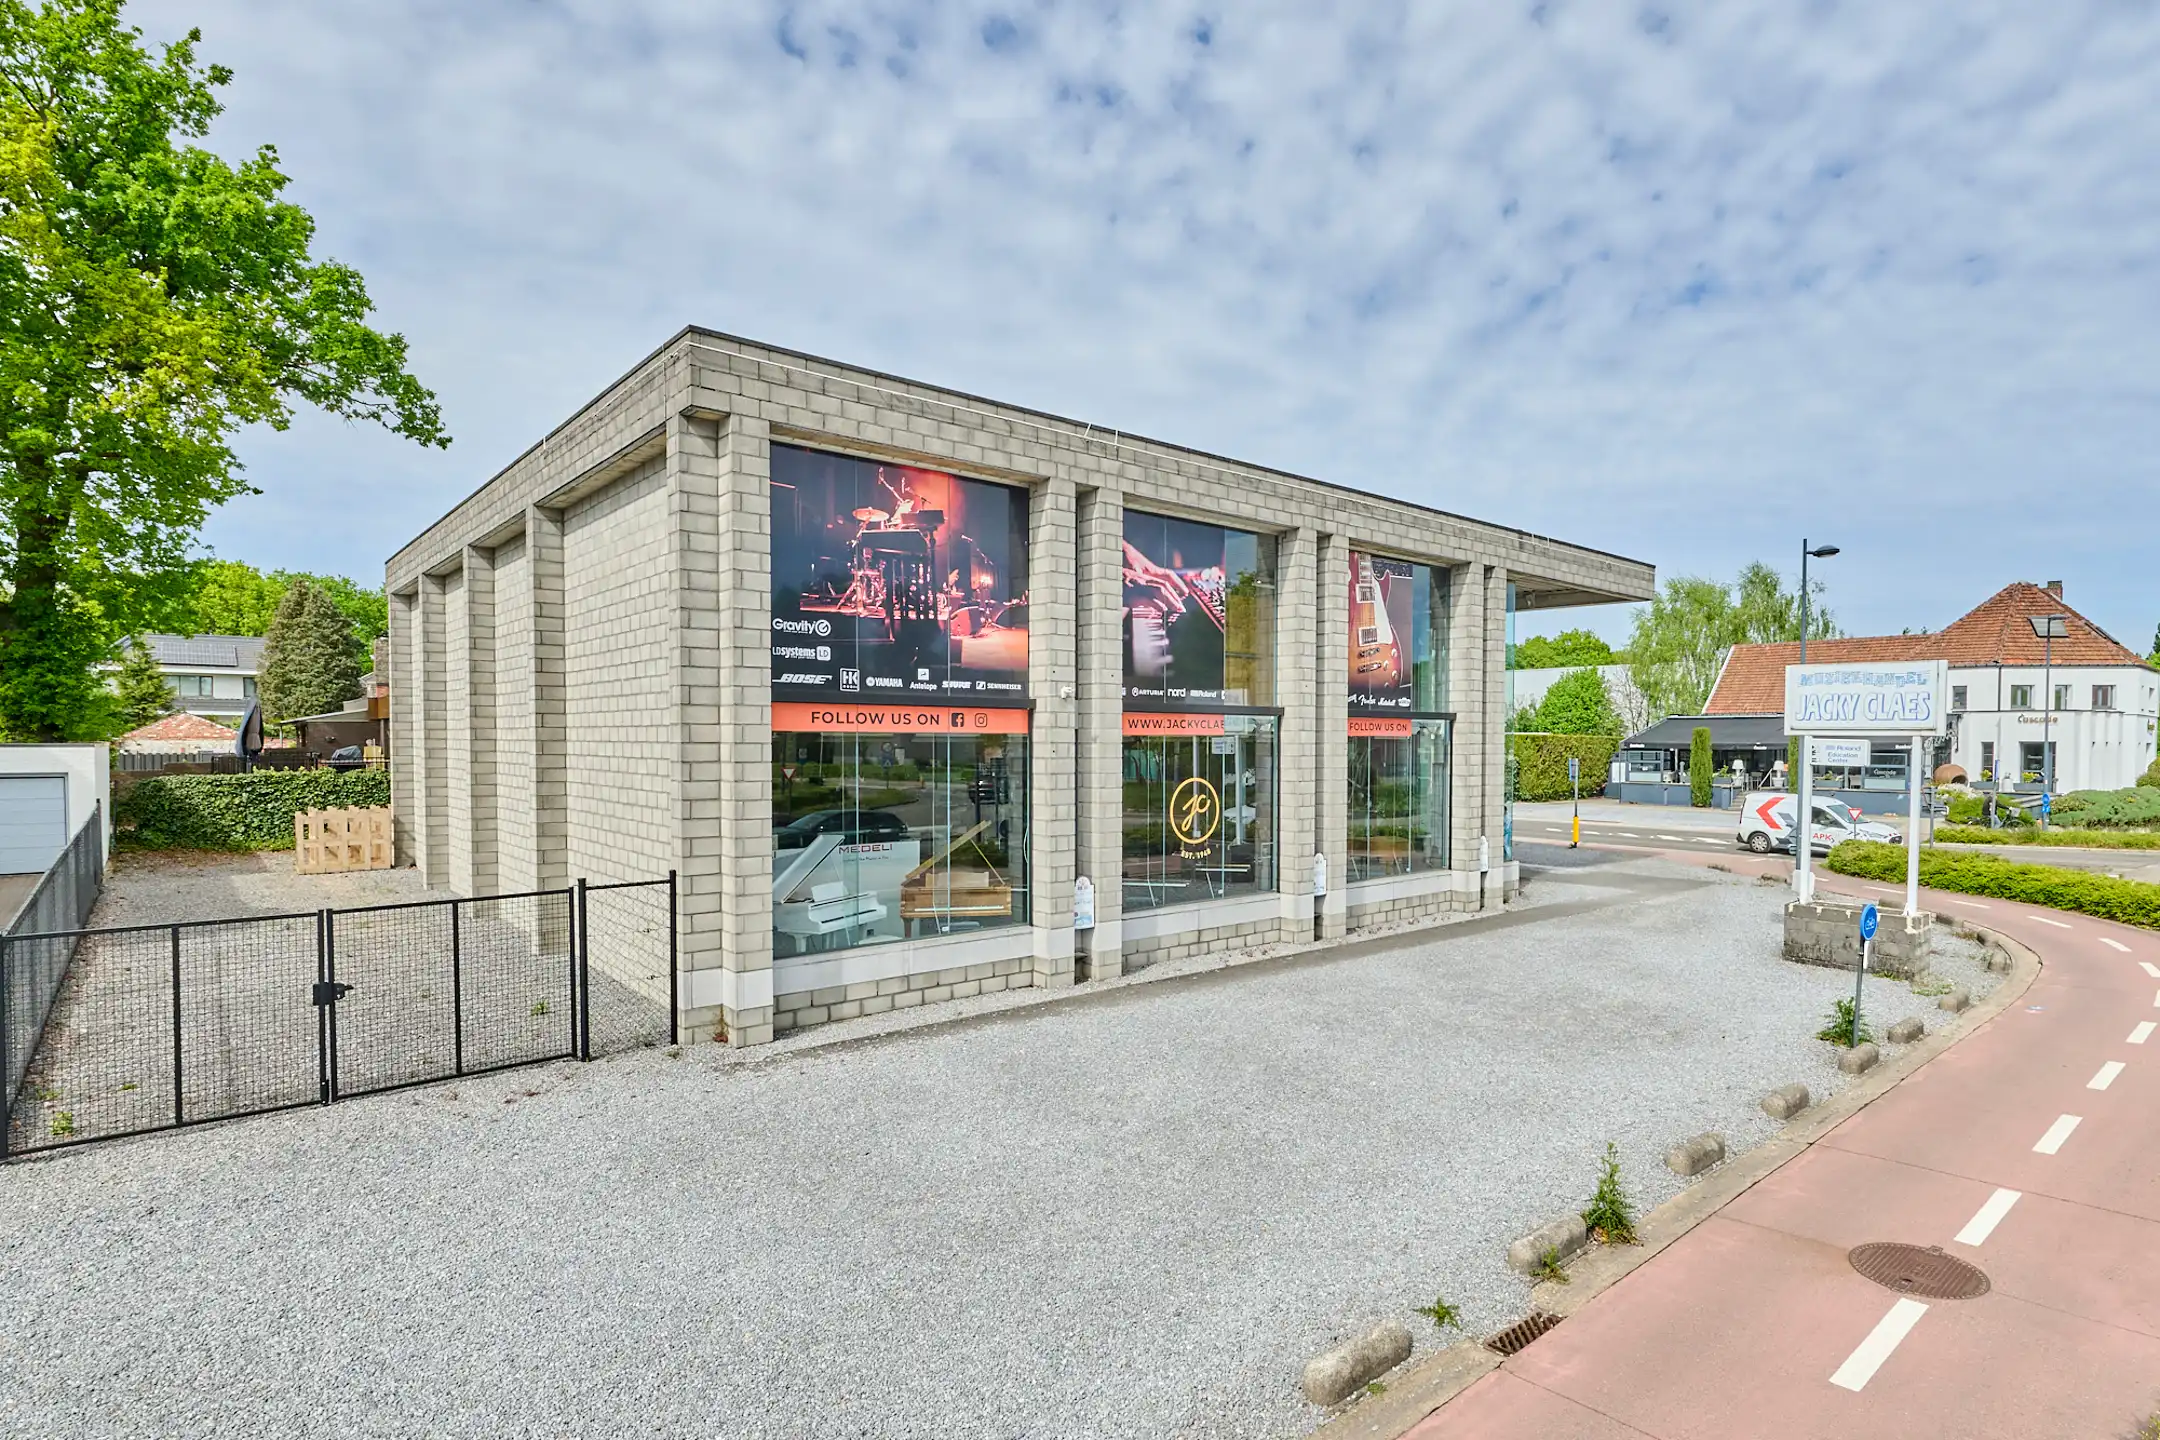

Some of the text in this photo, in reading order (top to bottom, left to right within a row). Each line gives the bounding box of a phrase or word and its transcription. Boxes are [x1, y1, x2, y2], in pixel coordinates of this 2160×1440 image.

[772, 618, 816, 634] Gravity
[776, 673, 832, 684] BOSE
[875, 677, 903, 688] YAMAHA
[909, 681, 938, 691] Antelope
[1167, 687, 1186, 698] nord
[1795, 691, 1931, 721] JACKY CLAES
[811, 711, 940, 725] FOLLOW US ON
[1349, 722, 1408, 732] FOLLOW US ON
[1813, 832, 1832, 840] APK
[838, 843, 893, 854] MEDELI
